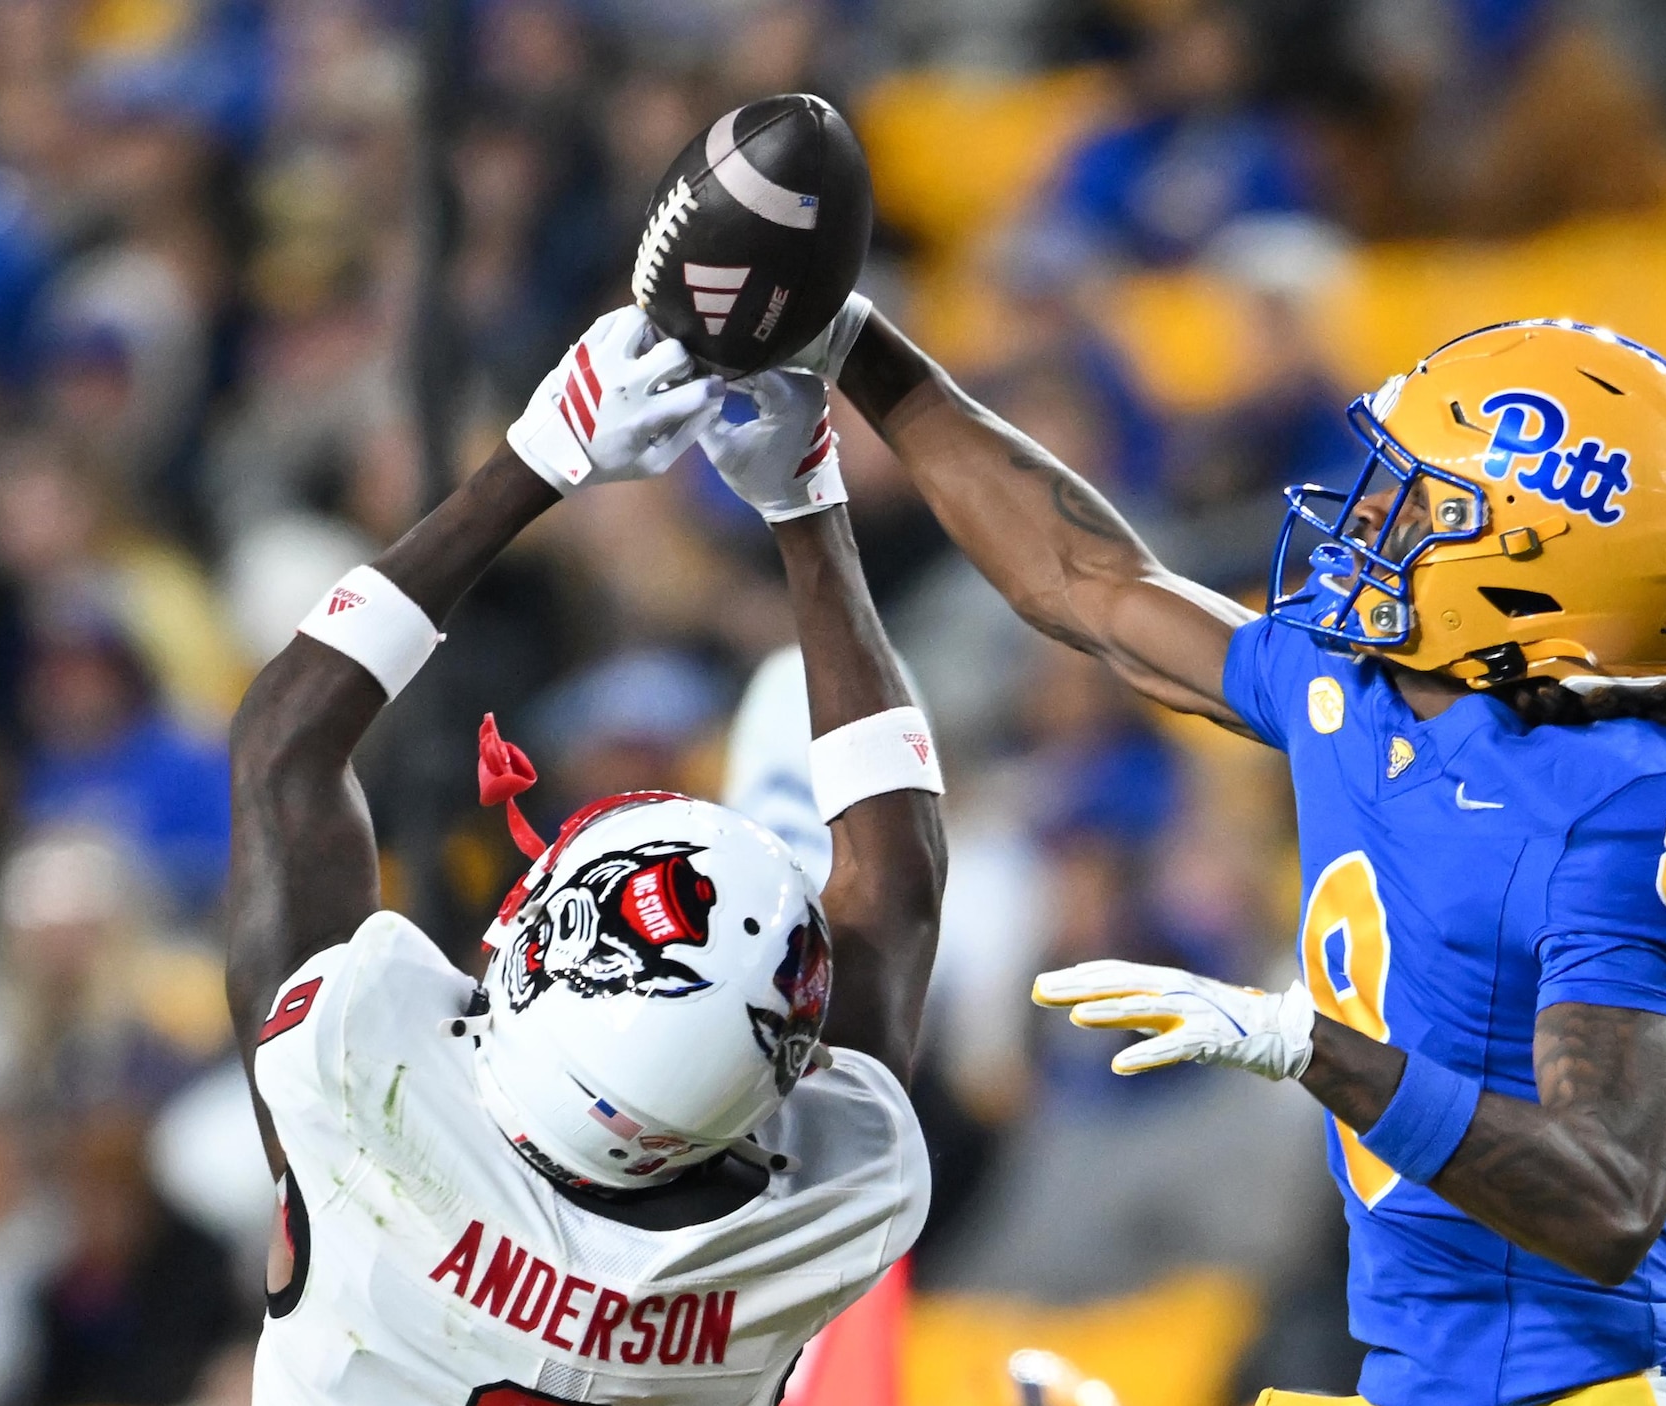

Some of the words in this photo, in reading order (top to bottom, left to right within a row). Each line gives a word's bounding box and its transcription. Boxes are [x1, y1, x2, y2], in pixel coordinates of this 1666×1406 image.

[753, 285, 790, 342] DIME
[1480, 388, 1630, 527] Pitt
[633, 872, 658, 897] NC
[635, 894, 676, 940] STATE
[429, 1219, 738, 1366] ANDERSON
